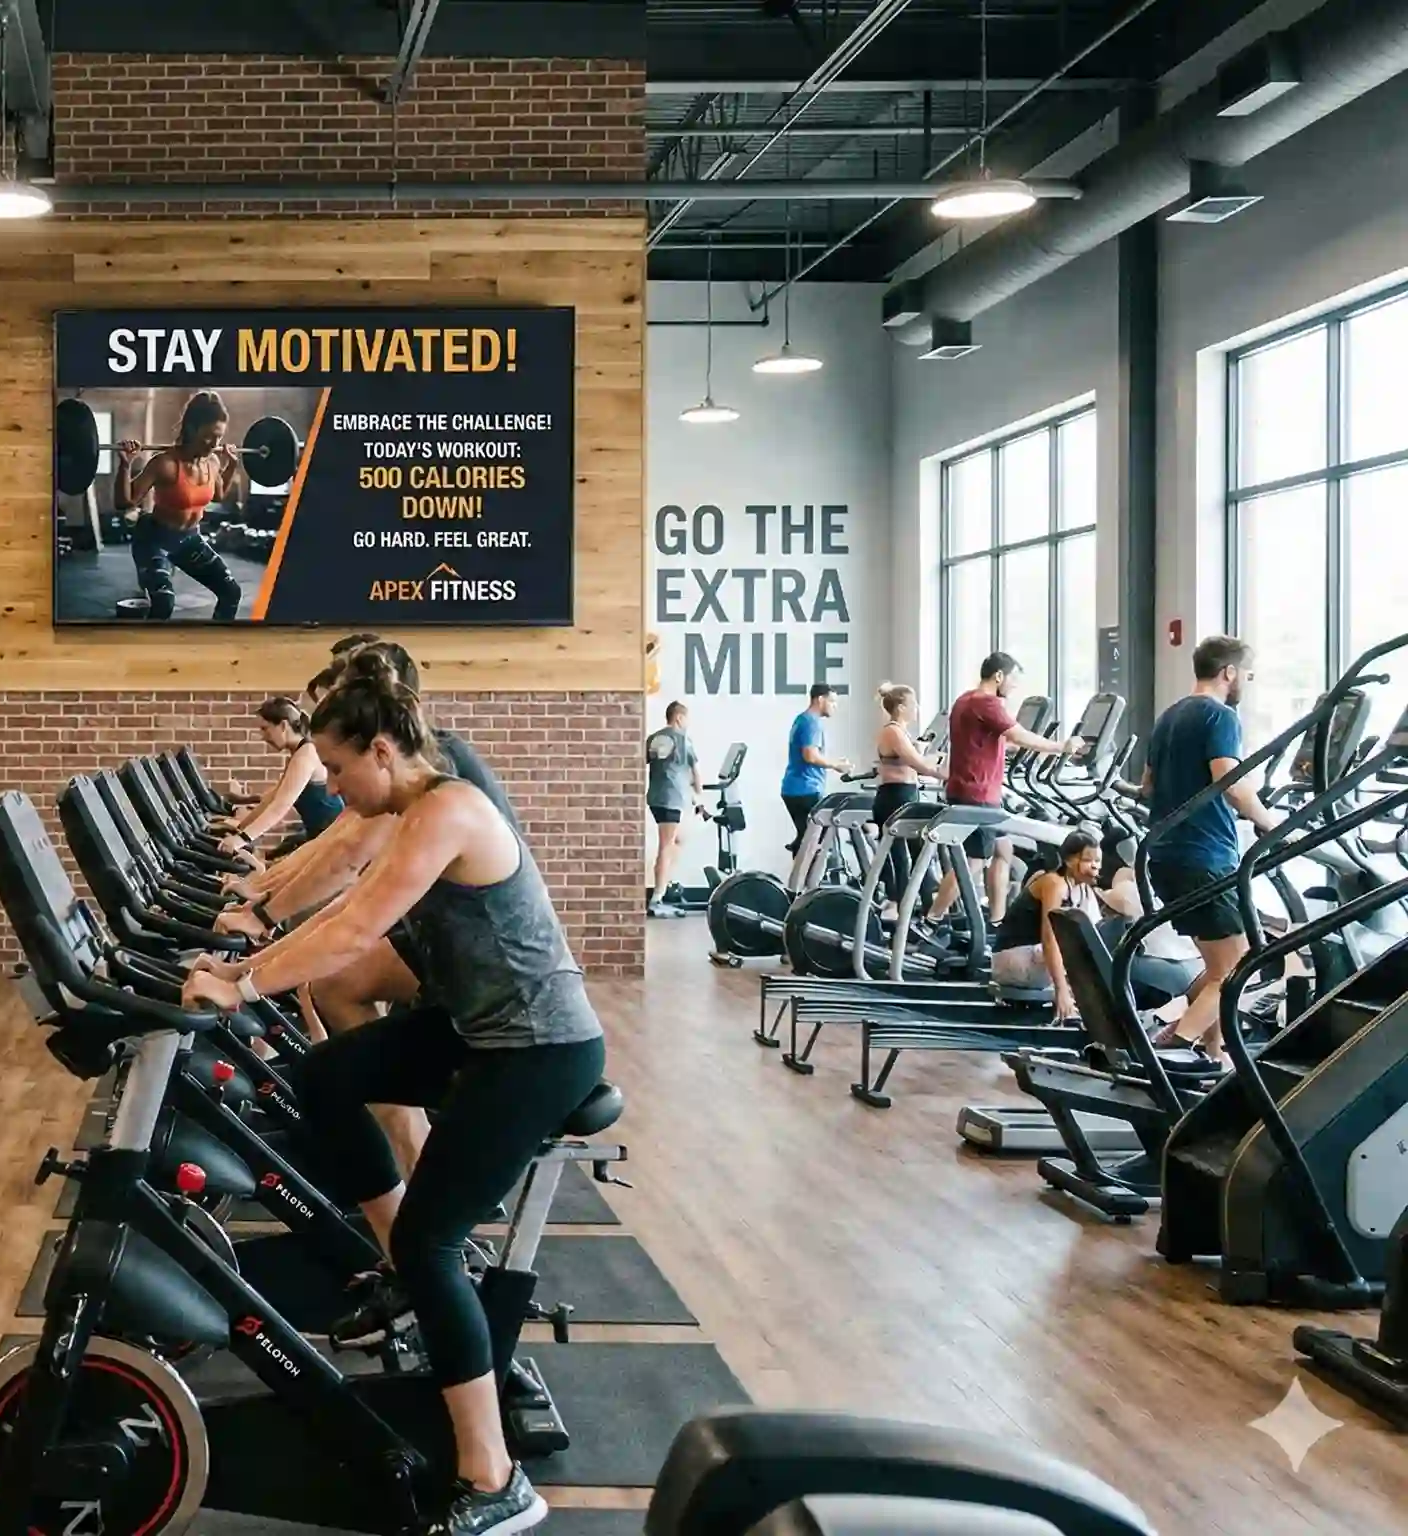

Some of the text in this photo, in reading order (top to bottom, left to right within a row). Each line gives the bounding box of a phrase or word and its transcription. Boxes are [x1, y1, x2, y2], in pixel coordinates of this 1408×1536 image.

[107, 328, 518, 373] STAY MOTIVATED!
[334, 415, 552, 430] EMBRACE THE CHALLENGE!
[364, 442, 521, 459] TODAY'S WORKOUT:
[359, 466, 525, 489] 500 CALORIES
[402, 497, 482, 519] DOWN!
[353, 532, 532, 548] GO HARD. FEEL GREAT.
[655, 505, 849, 555] GO THE
[370, 581, 516, 601] APEX FITNESS
[656, 568, 851, 623] EXTRA
[684, 632, 850, 695] MILE
[276, 1184, 314, 1218] PELOTON
[256, 1332, 300, 1376] PELOTON
